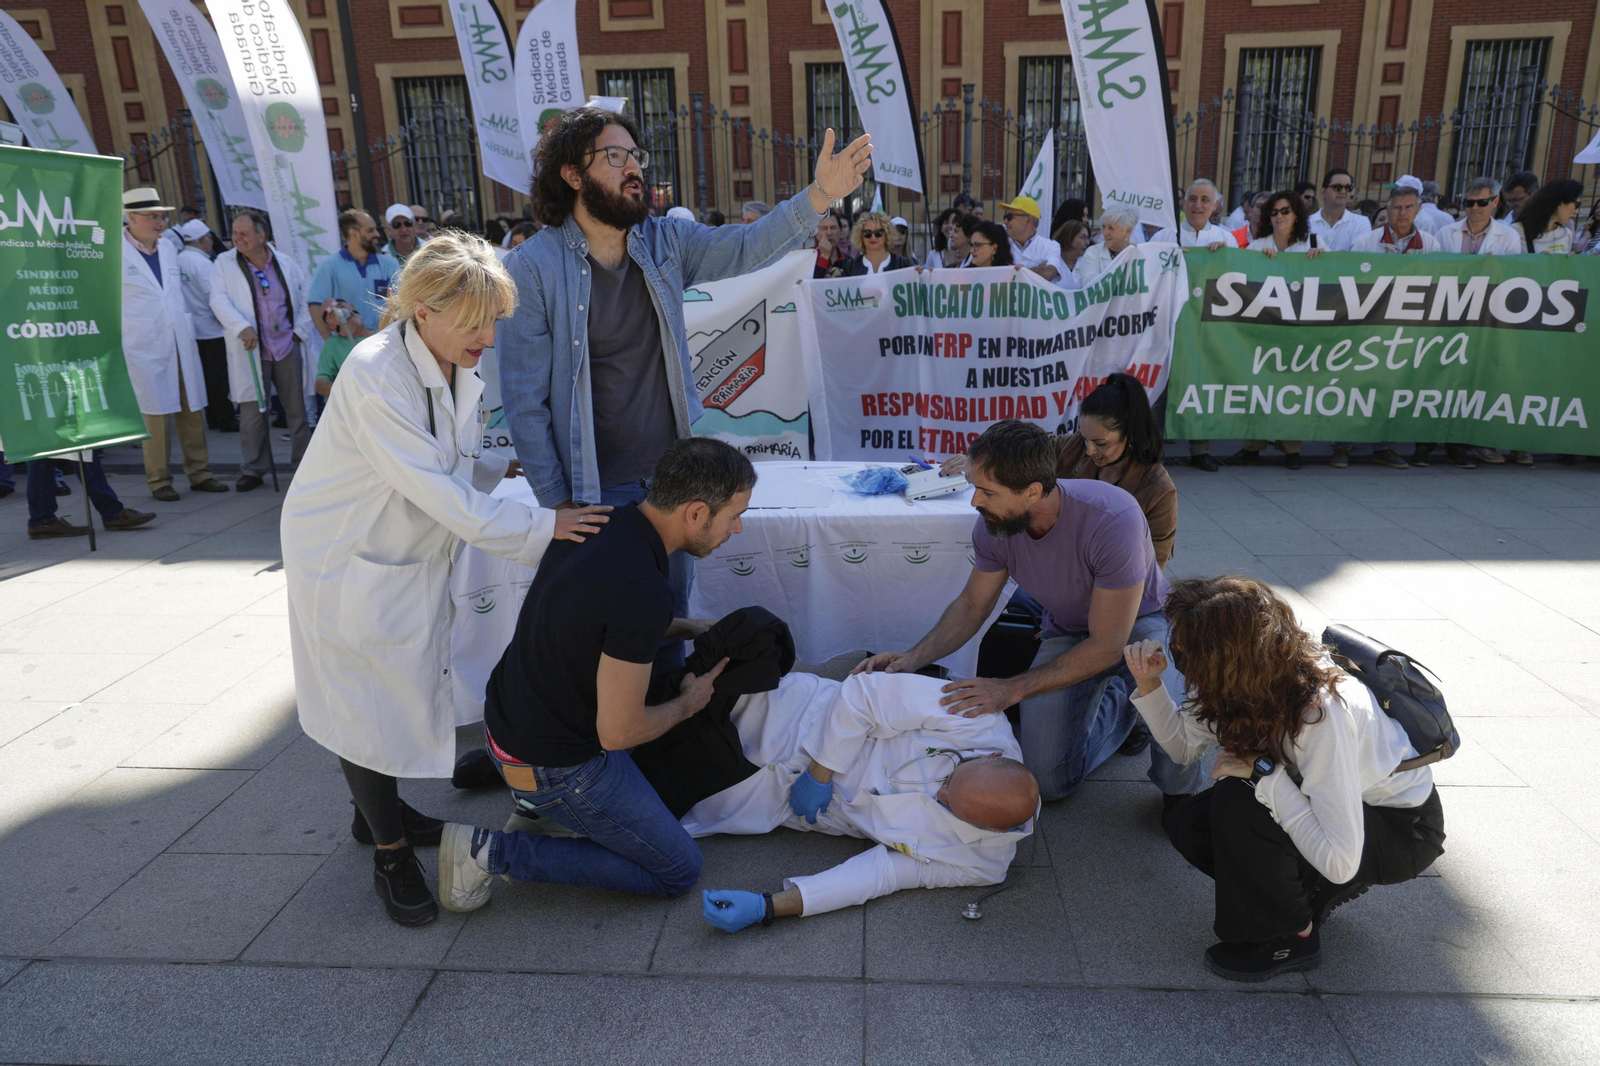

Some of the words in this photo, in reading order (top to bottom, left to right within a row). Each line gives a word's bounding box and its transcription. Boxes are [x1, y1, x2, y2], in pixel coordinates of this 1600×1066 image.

[541, 30, 552, 49] de
[529, 38, 545, 105] Sindicato
[543, 54, 558, 104] Médico
[556, 41, 572, 102] Granada
[0, 238, 35, 248] ndicato
[16, 269, 79, 280] SINDICATO
[29, 282, 75, 295] MÉDICO
[26, 300, 79, 311] ANDALUZ
[989, 270, 1071, 321] MÉDICO
[1210, 271, 1581, 327] SALVEMOS
[6, 318, 101, 339] CÓRDOBA
[878, 335, 917, 358] POR
[934, 332, 973, 359] FRP
[978, 337, 1002, 359] EN
[1006, 324, 1098, 360] PRIMARIA
[1251, 326, 1470, 375] nuestra
[965, 368, 978, 389] A
[982, 360, 1069, 389] NUESTRA
[1051, 390, 1068, 416] Y
[1176, 378, 1377, 419] ATENCIÓN
[1388, 388, 1589, 429] PRIMARIA
[860, 429, 894, 449] POR
[897, 429, 914, 450] EL
